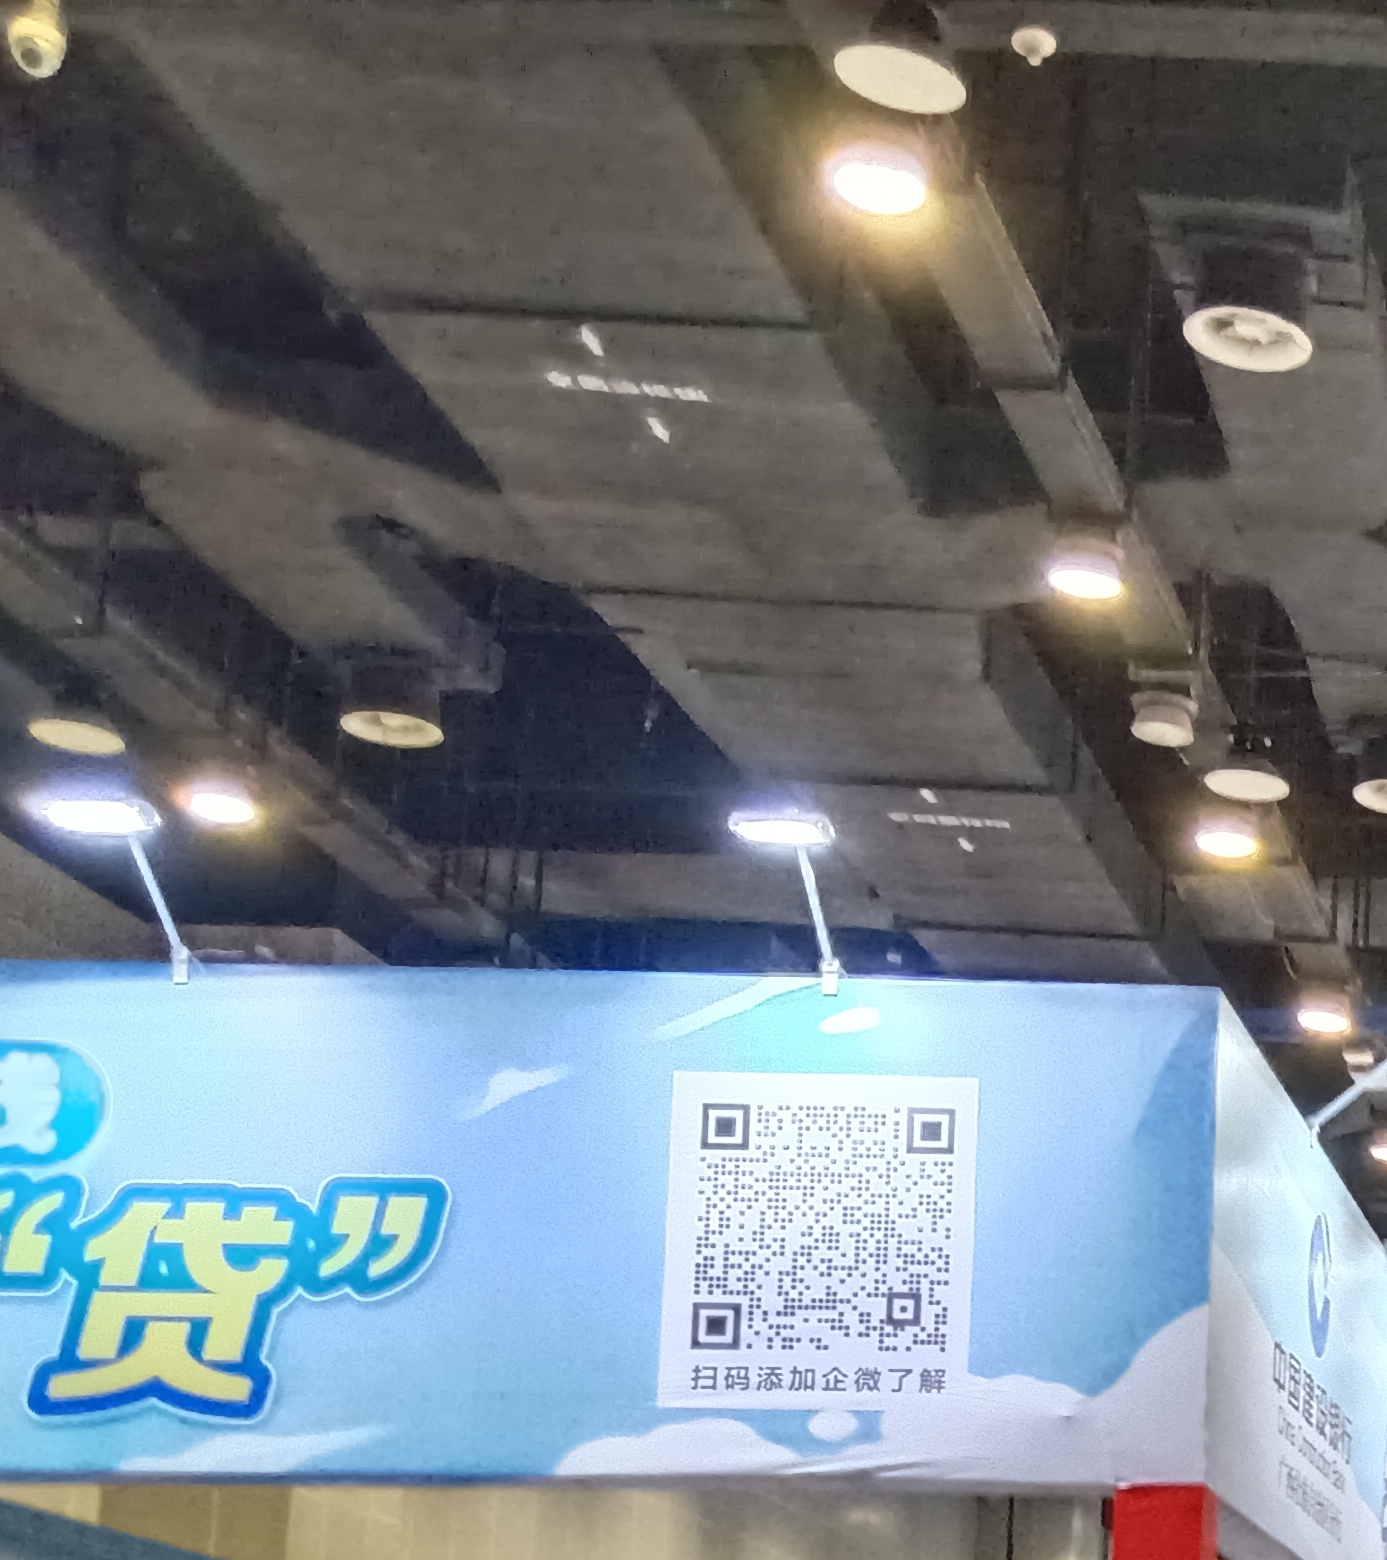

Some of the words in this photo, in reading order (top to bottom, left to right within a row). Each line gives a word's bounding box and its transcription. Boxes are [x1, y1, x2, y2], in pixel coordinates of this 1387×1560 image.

[690, 1363, 948, 1397] 扫码添加企微了解
